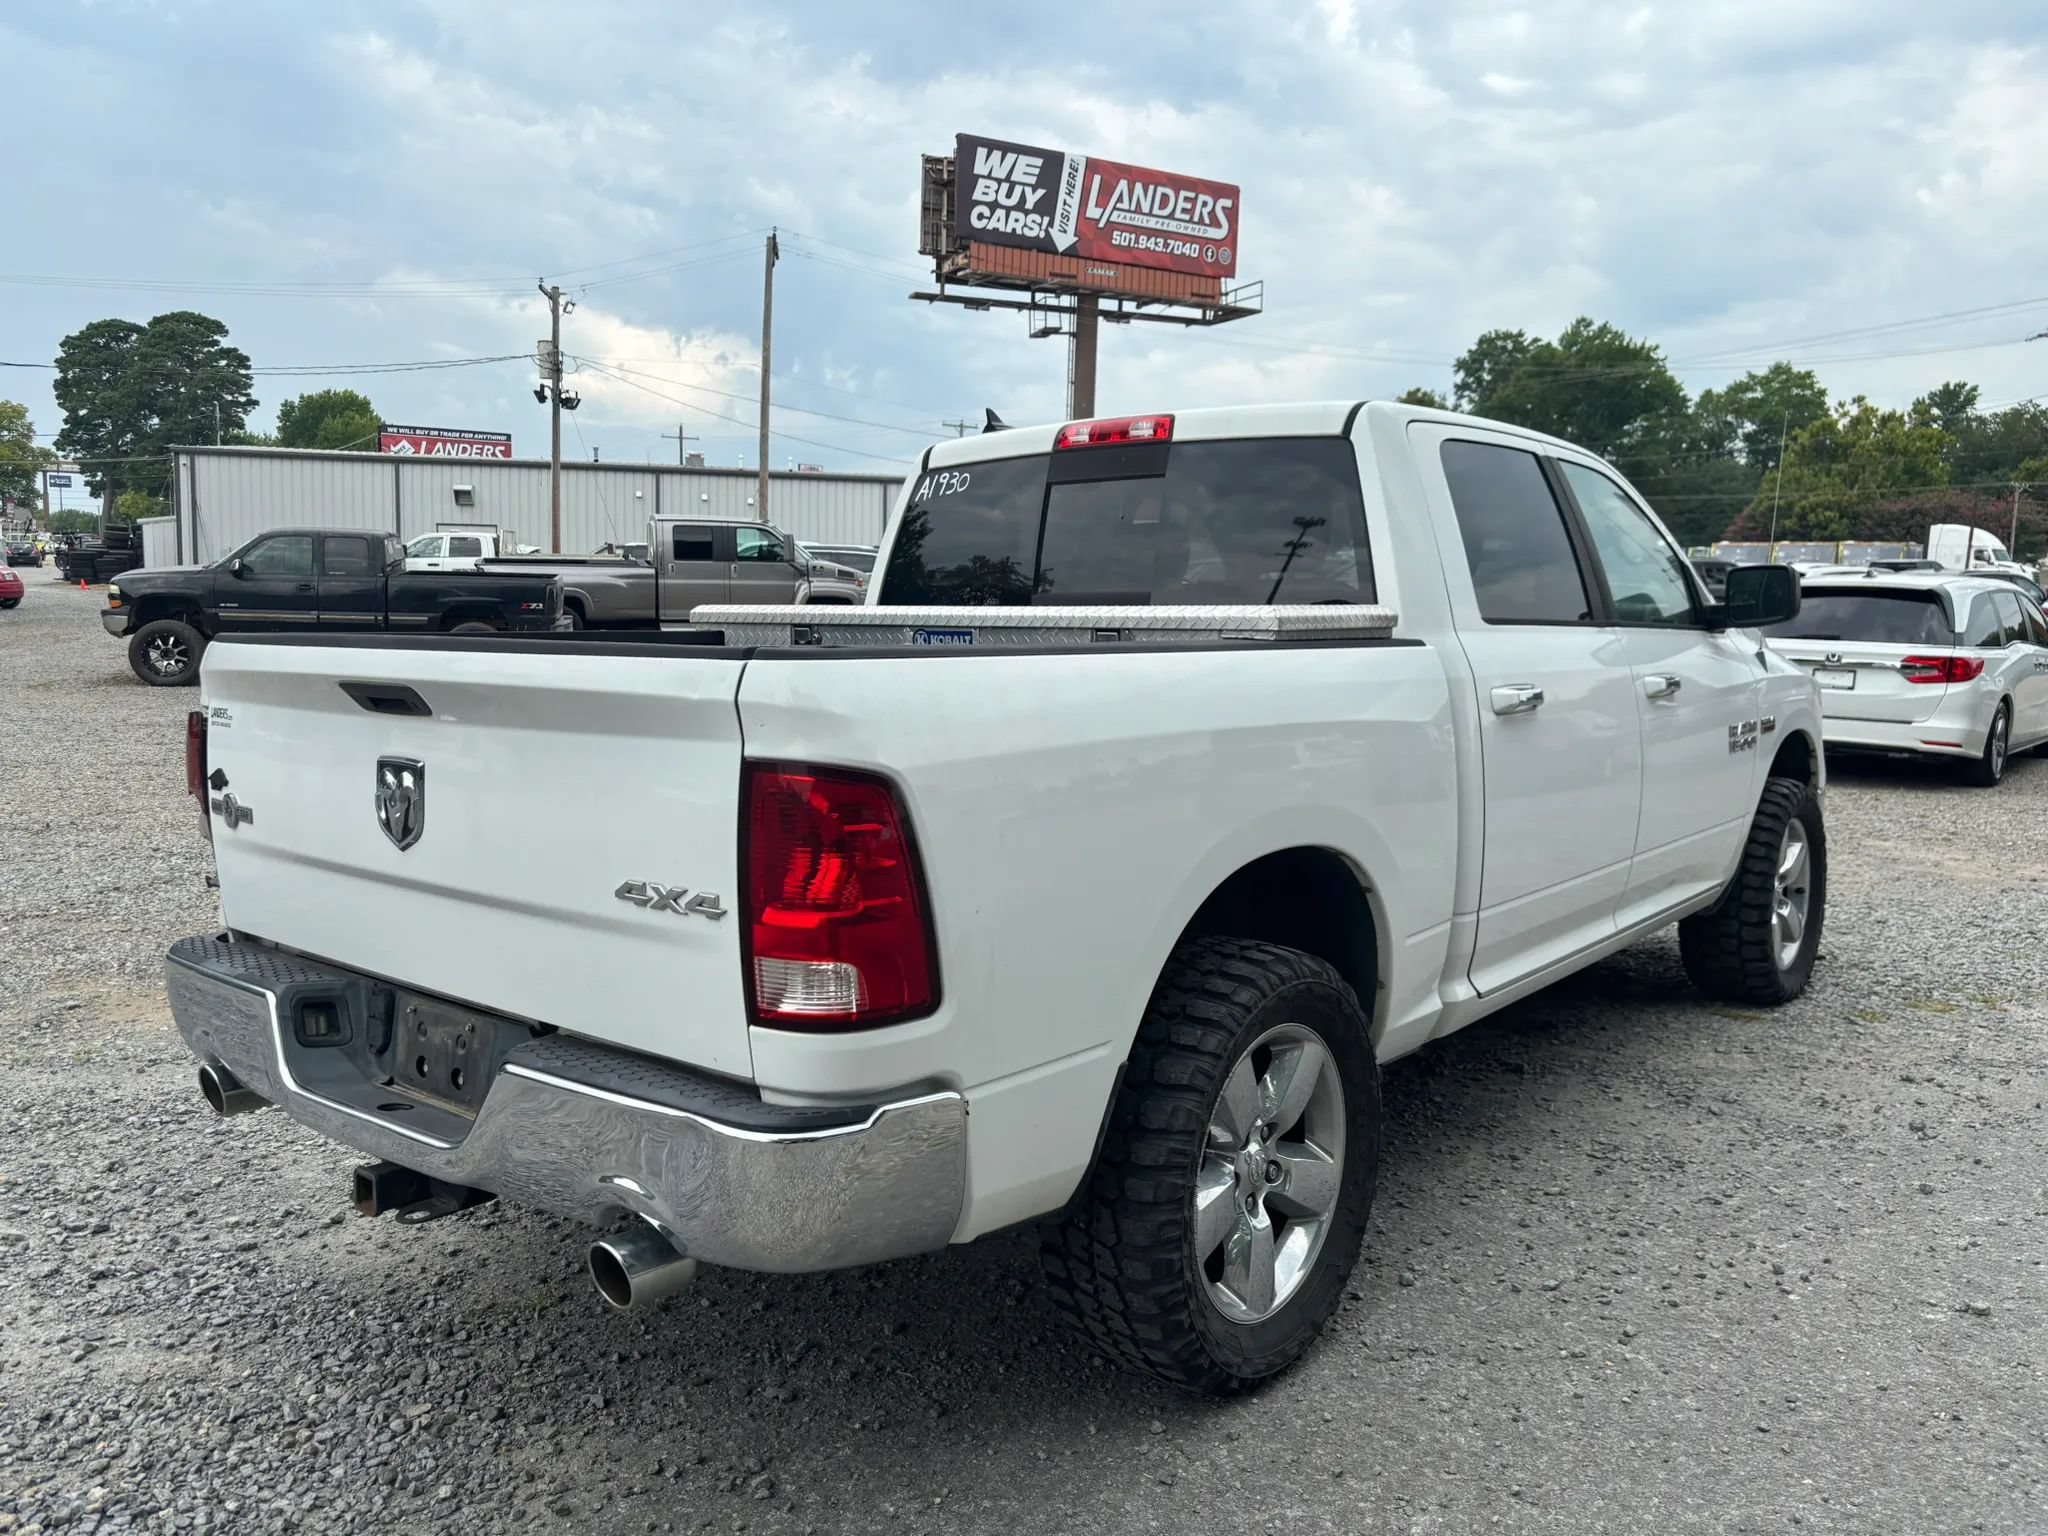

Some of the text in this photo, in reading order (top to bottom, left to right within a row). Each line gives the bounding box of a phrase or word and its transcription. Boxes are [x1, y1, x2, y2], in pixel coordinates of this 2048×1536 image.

[973, 146, 1044, 185] WE
[971, 177, 1047, 210] BUY
[1058, 157, 1080, 235] VISIT HERE!
[1085, 174, 1233, 240] LANDERS
[970, 204, 1050, 239] CARS!
[1115, 212, 1209, 235] FAMILY PRE-OWNED
[1111, 230, 1200, 258] 501.943.7040
[420, 441, 505, 458] LANDERS
[915, 472, 970, 502] A1930
[930, 634, 971, 645] KOBALT
